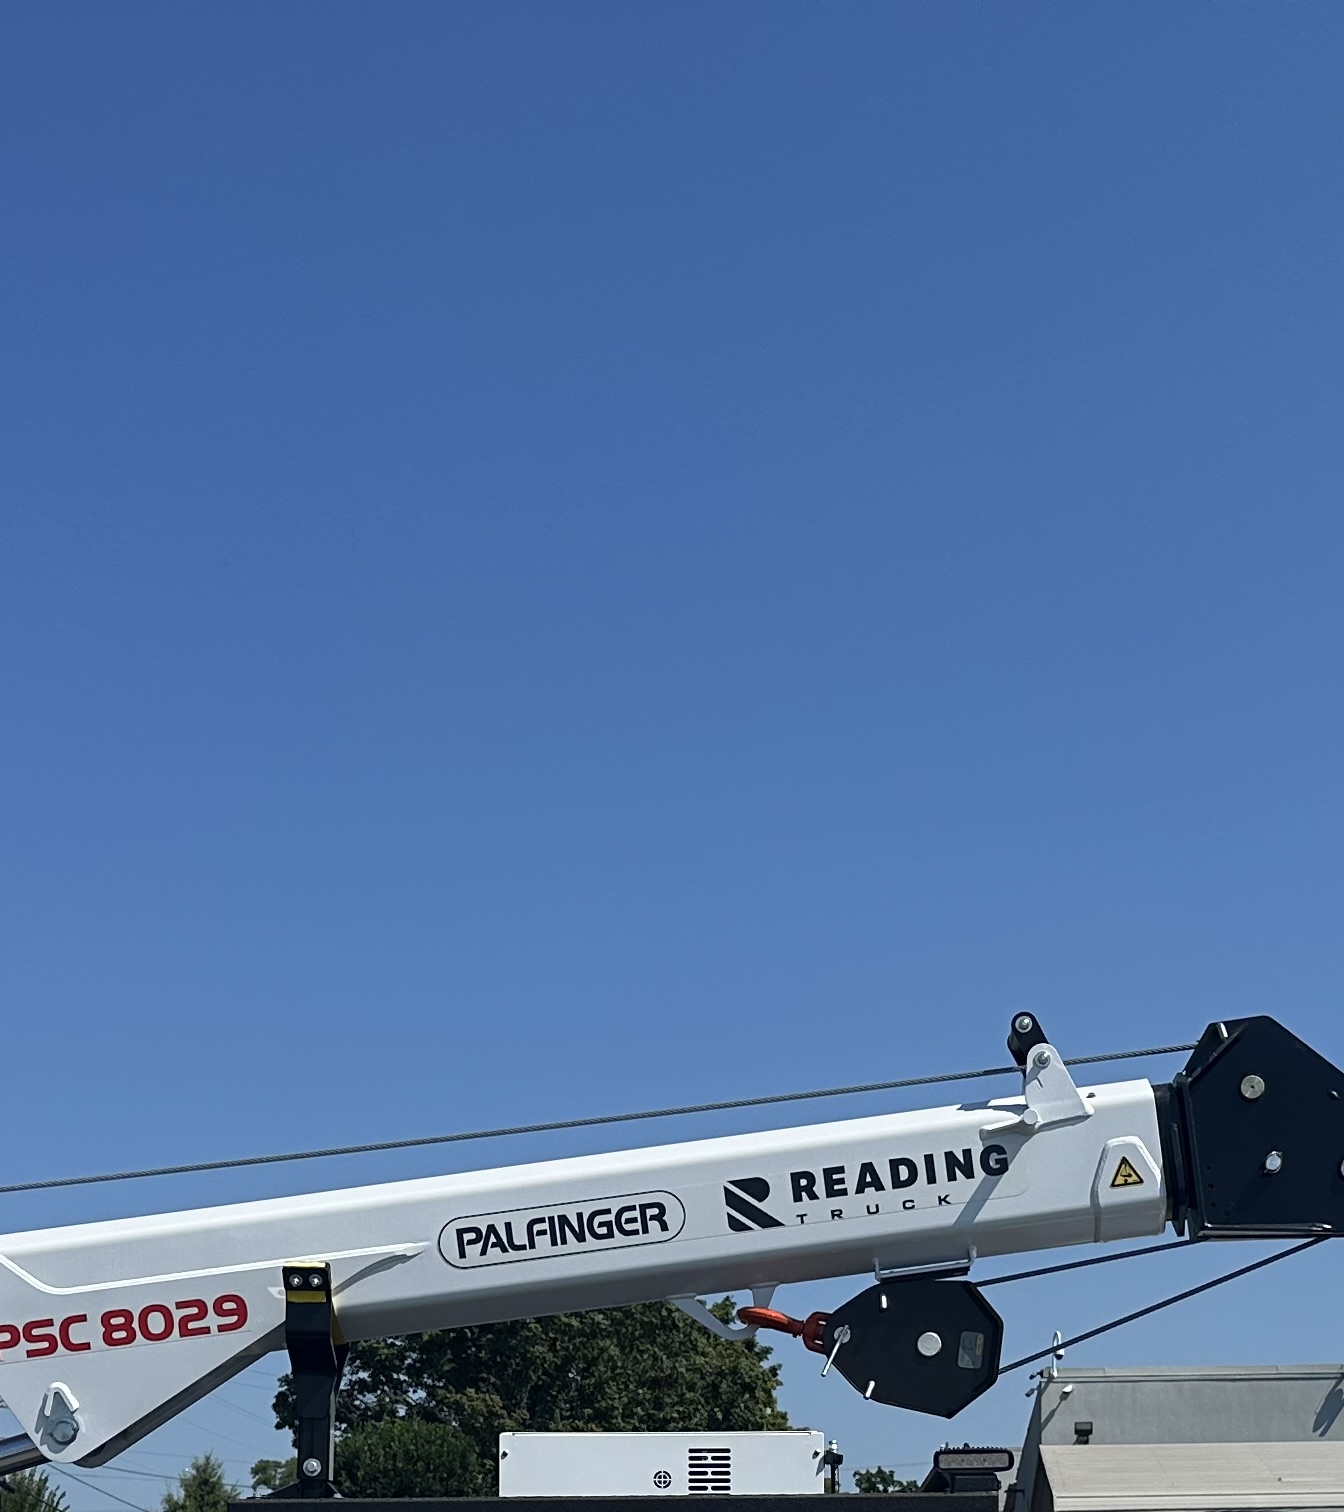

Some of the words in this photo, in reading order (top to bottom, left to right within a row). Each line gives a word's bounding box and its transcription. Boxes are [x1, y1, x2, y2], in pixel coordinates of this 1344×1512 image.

[789, 1144, 1009, 1203] READING
[455, 1202, 670, 1260] PALFINGER
[795, 1194, 953, 1225] TRUCK
[102, 1295, 249, 1347] 8029
